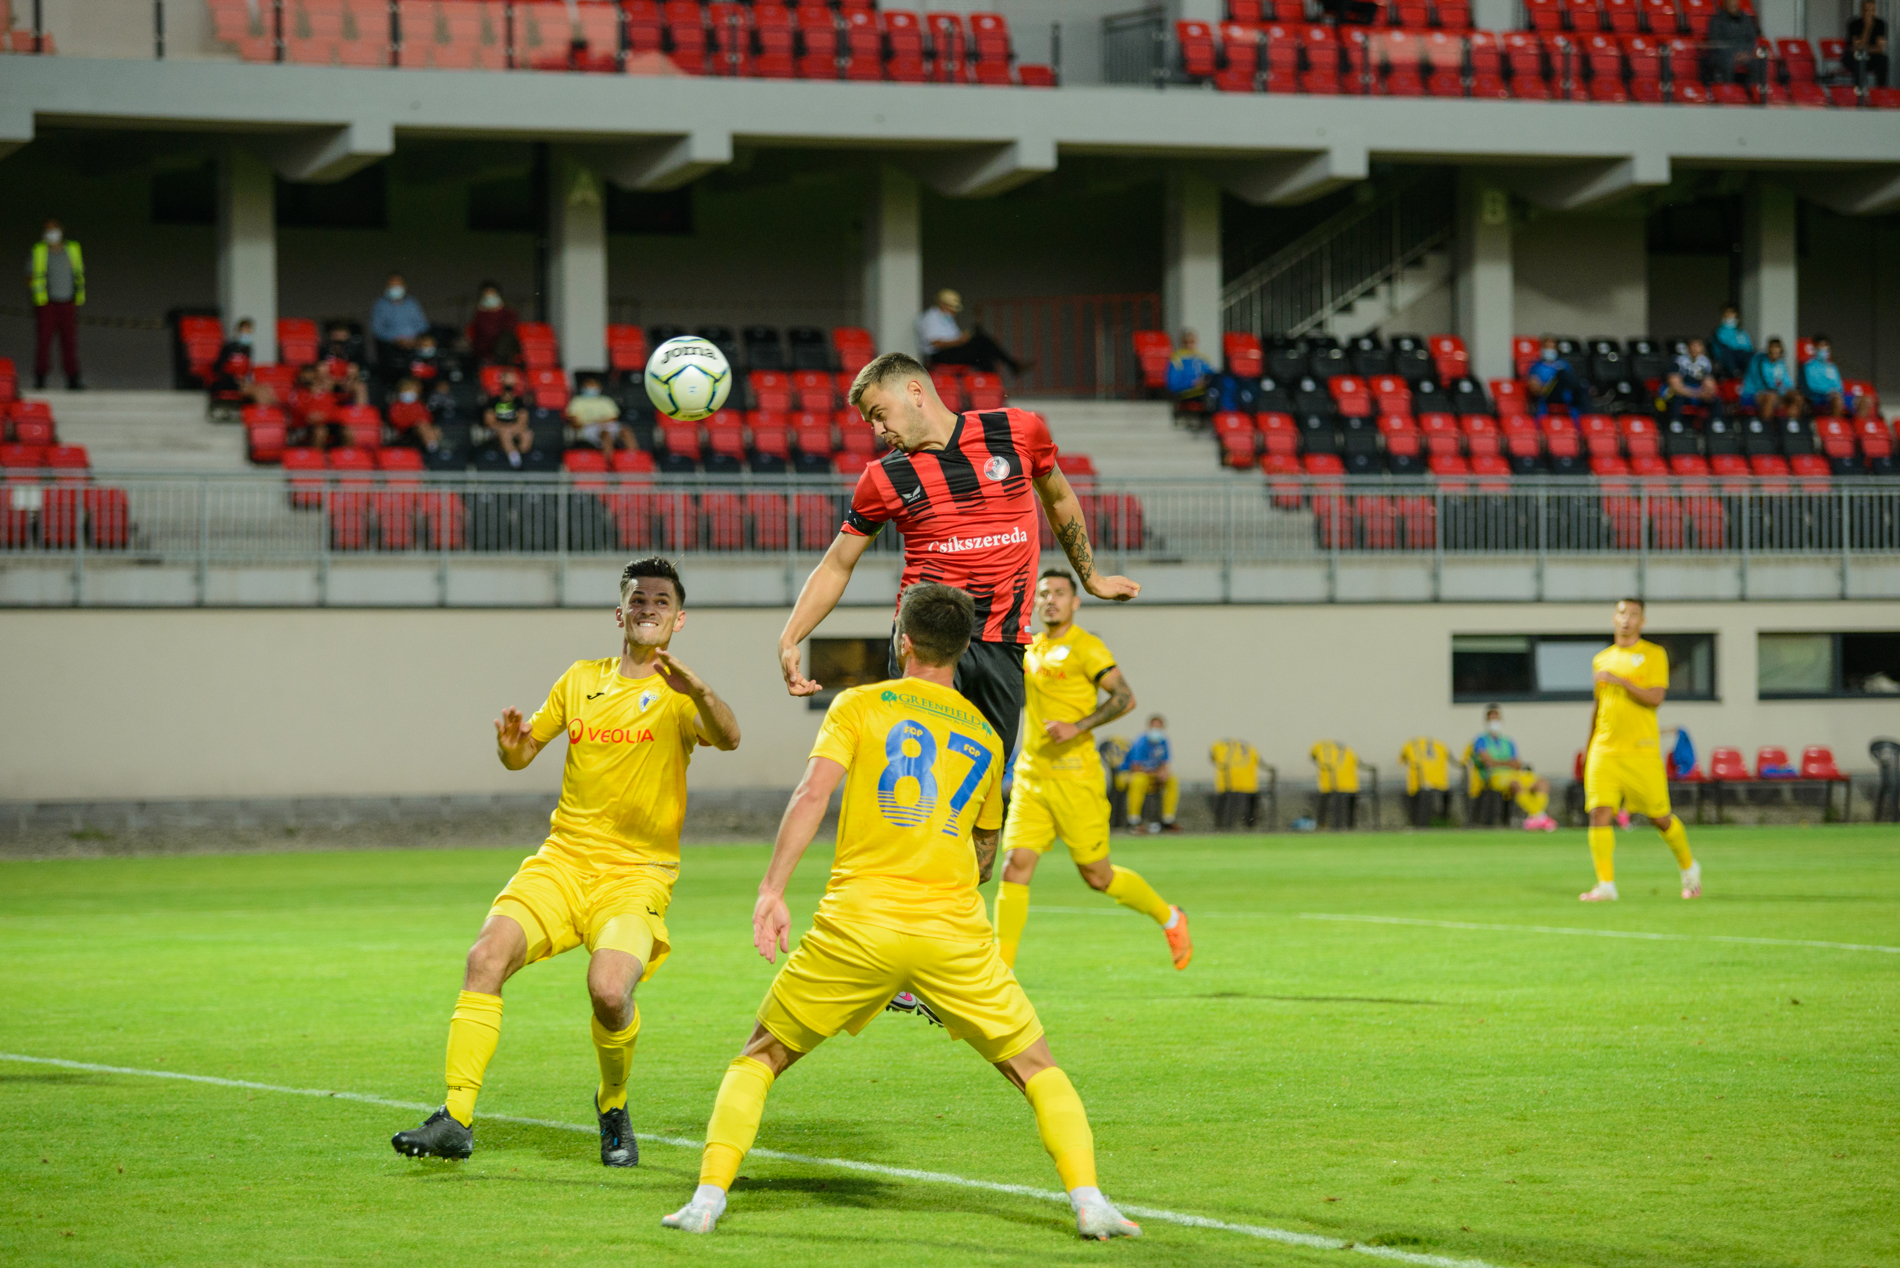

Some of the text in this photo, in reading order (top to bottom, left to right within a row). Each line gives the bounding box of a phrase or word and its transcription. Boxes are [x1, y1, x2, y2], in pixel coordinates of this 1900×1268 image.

[899, 693, 981, 725] GREENFIELD
[588, 727, 655, 744] VEOLIA
[903, 725, 924, 738] FCP
[963, 743, 981, 758] FCP
[877, 719, 993, 838] 87
